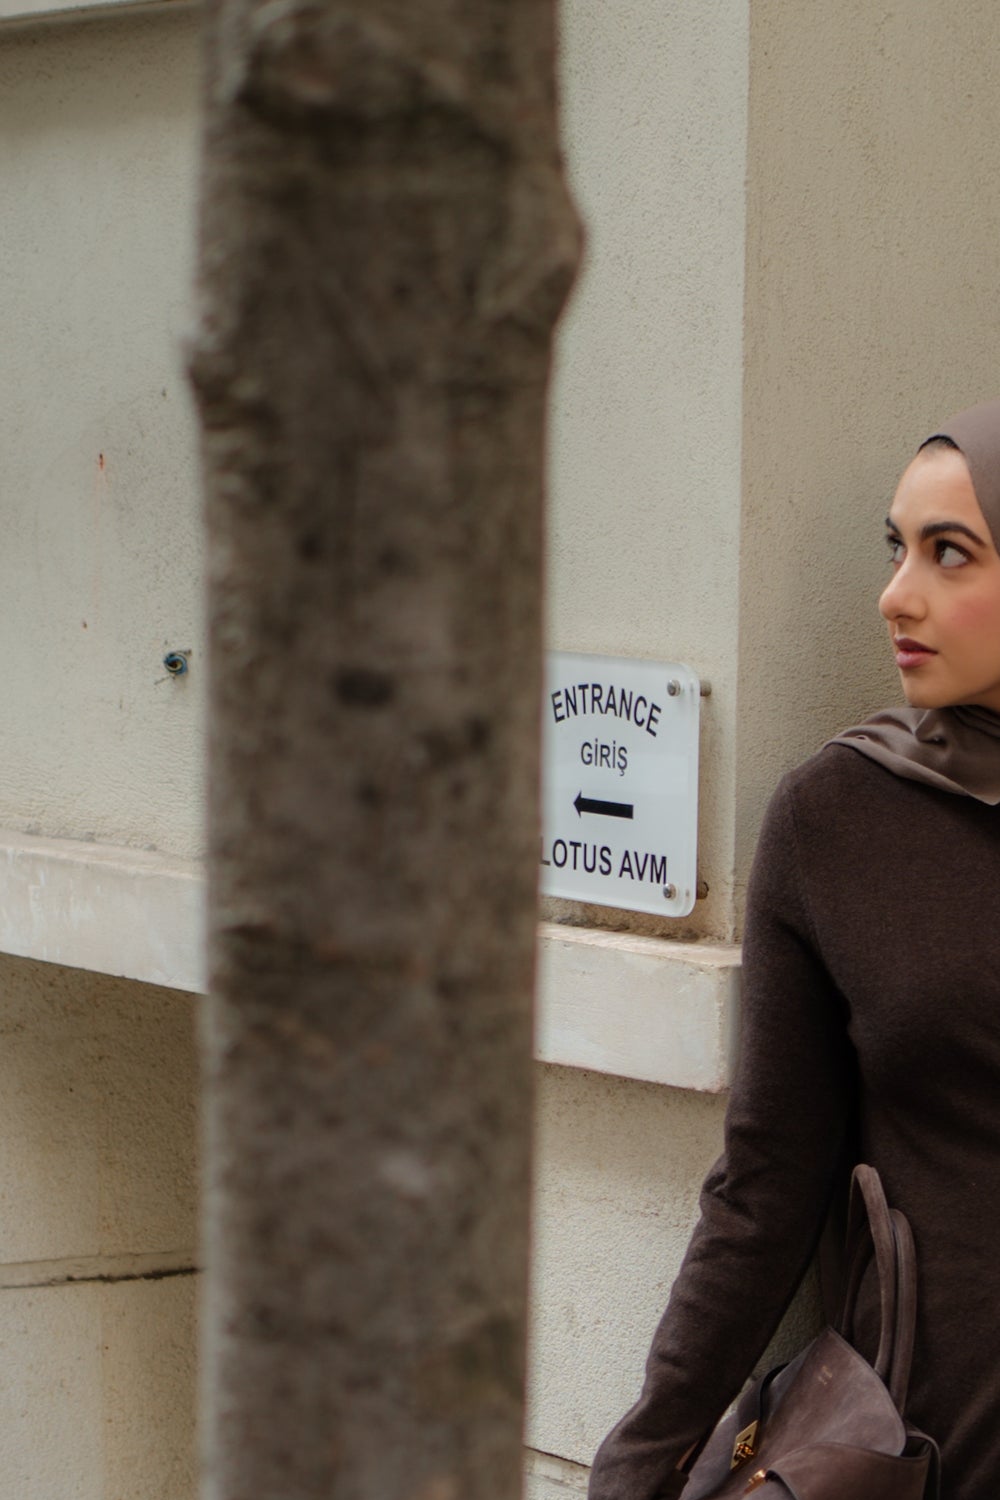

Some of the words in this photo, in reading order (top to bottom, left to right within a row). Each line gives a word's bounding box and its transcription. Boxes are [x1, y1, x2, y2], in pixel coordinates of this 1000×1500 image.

[551, 683, 662, 737] ENTRANCE
[581, 738, 628, 776] GİRİŞ
[618, 850, 667, 884] AVM
